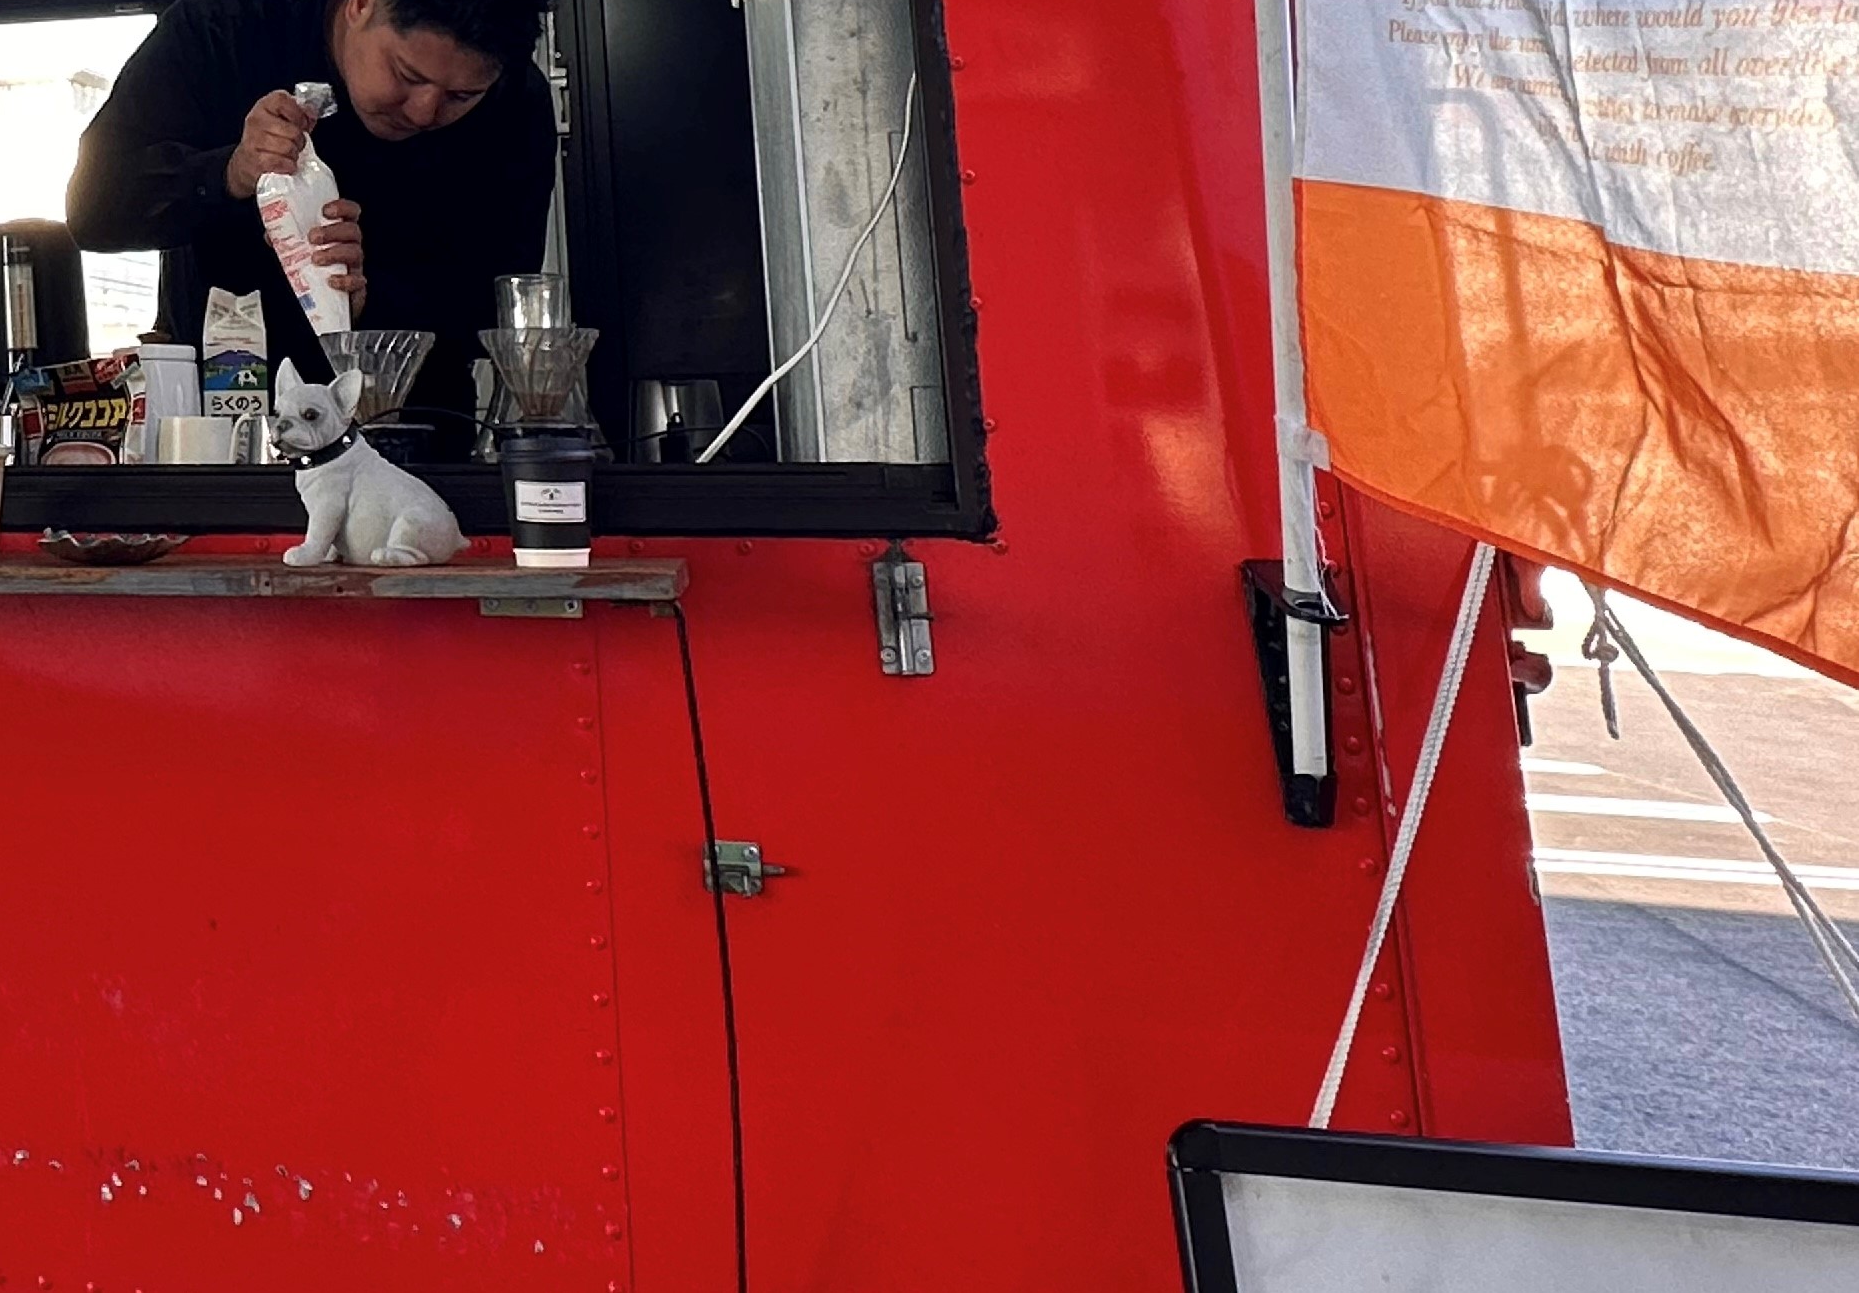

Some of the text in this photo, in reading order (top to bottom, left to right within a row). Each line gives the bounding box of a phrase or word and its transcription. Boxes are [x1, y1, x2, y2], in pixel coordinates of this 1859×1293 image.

[1573, 0, 1629, 26] where
[1704, 6, 1759, 38] you
[1697, 47, 1730, 76] all
[46, 397, 127, 430] ミルクココア
[211, 395, 263, 411] らくのう
